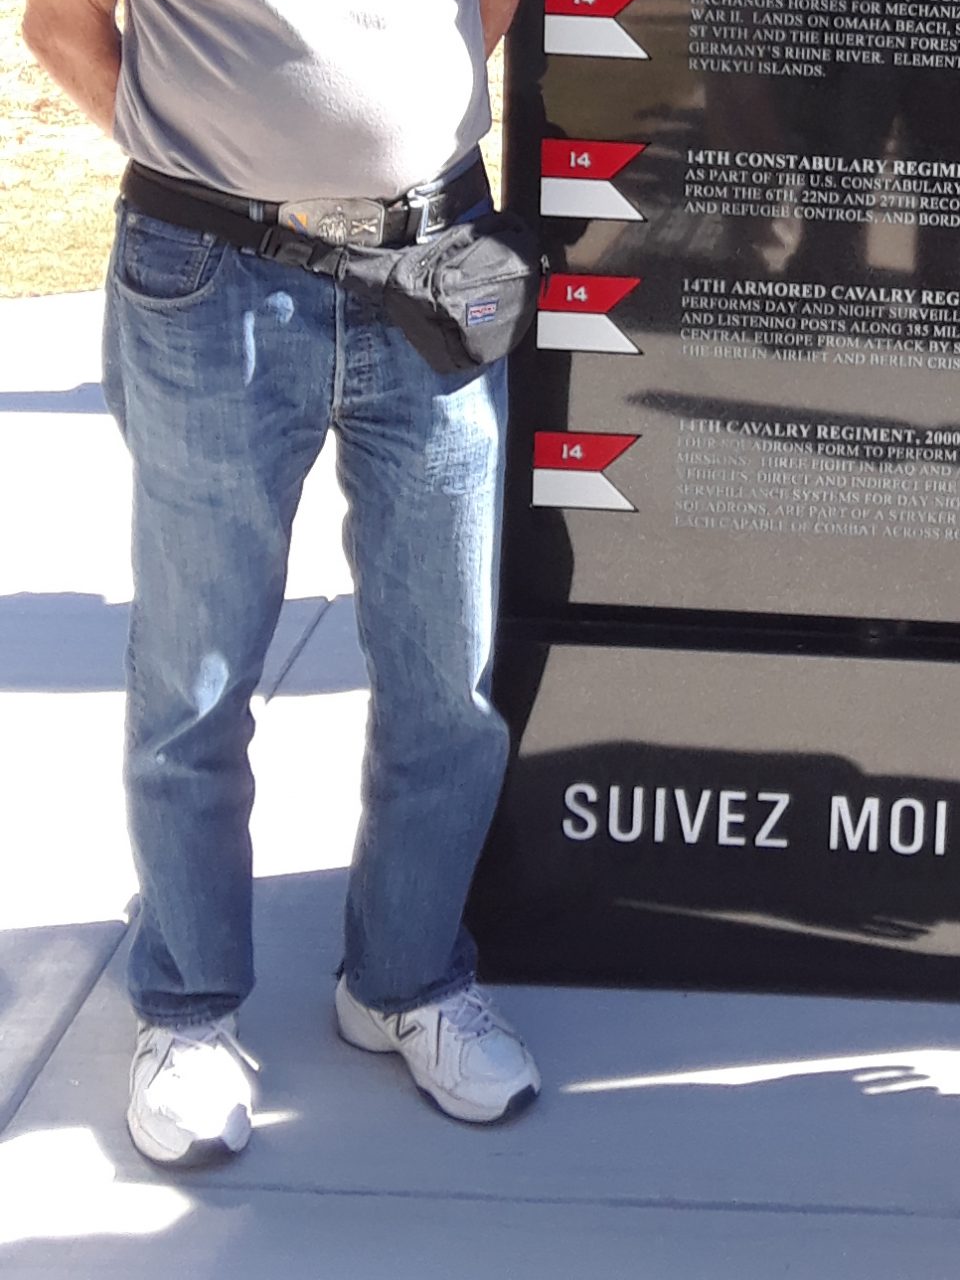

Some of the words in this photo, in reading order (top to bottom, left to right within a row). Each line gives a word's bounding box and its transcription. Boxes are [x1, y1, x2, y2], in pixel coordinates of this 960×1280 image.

[851, 0, 880, 14] FOR
[570, 151, 591, 168] 14
[687, 149, 729, 166] 14TH
[734, 151, 887, 174] CONSTABULARY
[684, 199, 717, 214] AND
[721, 201, 789, 218] REFUGEE
[882, 210, 915, 225] AND
[566, 285, 588, 301] 14
[683, 277, 725, 294] 14TH
[731, 279, 826, 299] ARMORED
[830, 284, 916, 304] CAVALRY
[681, 295, 760, 312] PERFORMS
[764, 299, 797, 314] DAY
[801, 301, 834, 316] AND
[838, 303, 884, 318] NIGHT
[726, 419, 810, 438] CAVALRY
[816, 424, 920, 444] REGIMENT,
[924, 429, 960, 446] 2000
[562, 443, 583, 459] 14
[562, 783, 790, 848] SUIVEZ
[829, 795, 947, 855] MOI
